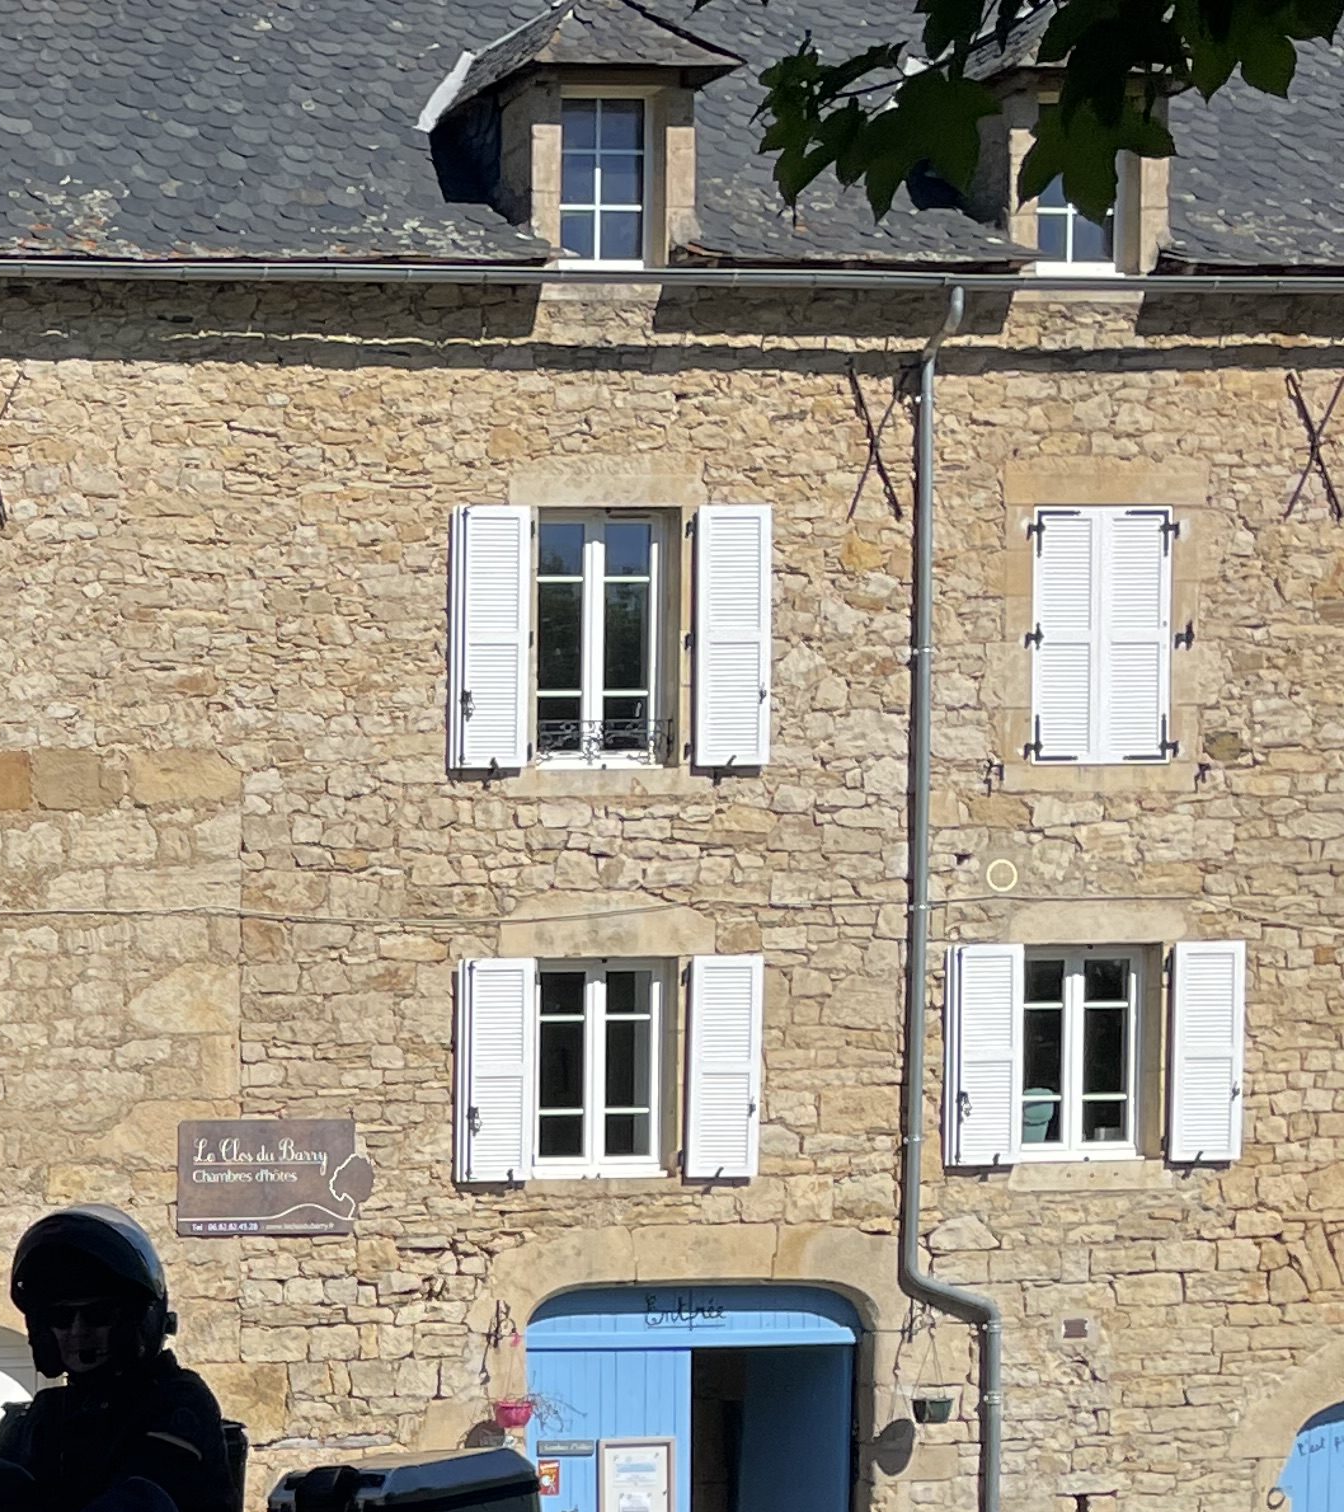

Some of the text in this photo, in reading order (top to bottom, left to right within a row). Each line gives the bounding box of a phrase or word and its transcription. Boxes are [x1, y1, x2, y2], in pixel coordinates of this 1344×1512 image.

[193, 1137, 328, 1176] Le Clos du Barry
[192, 1168, 298, 1183] Chambres d'hôtes
